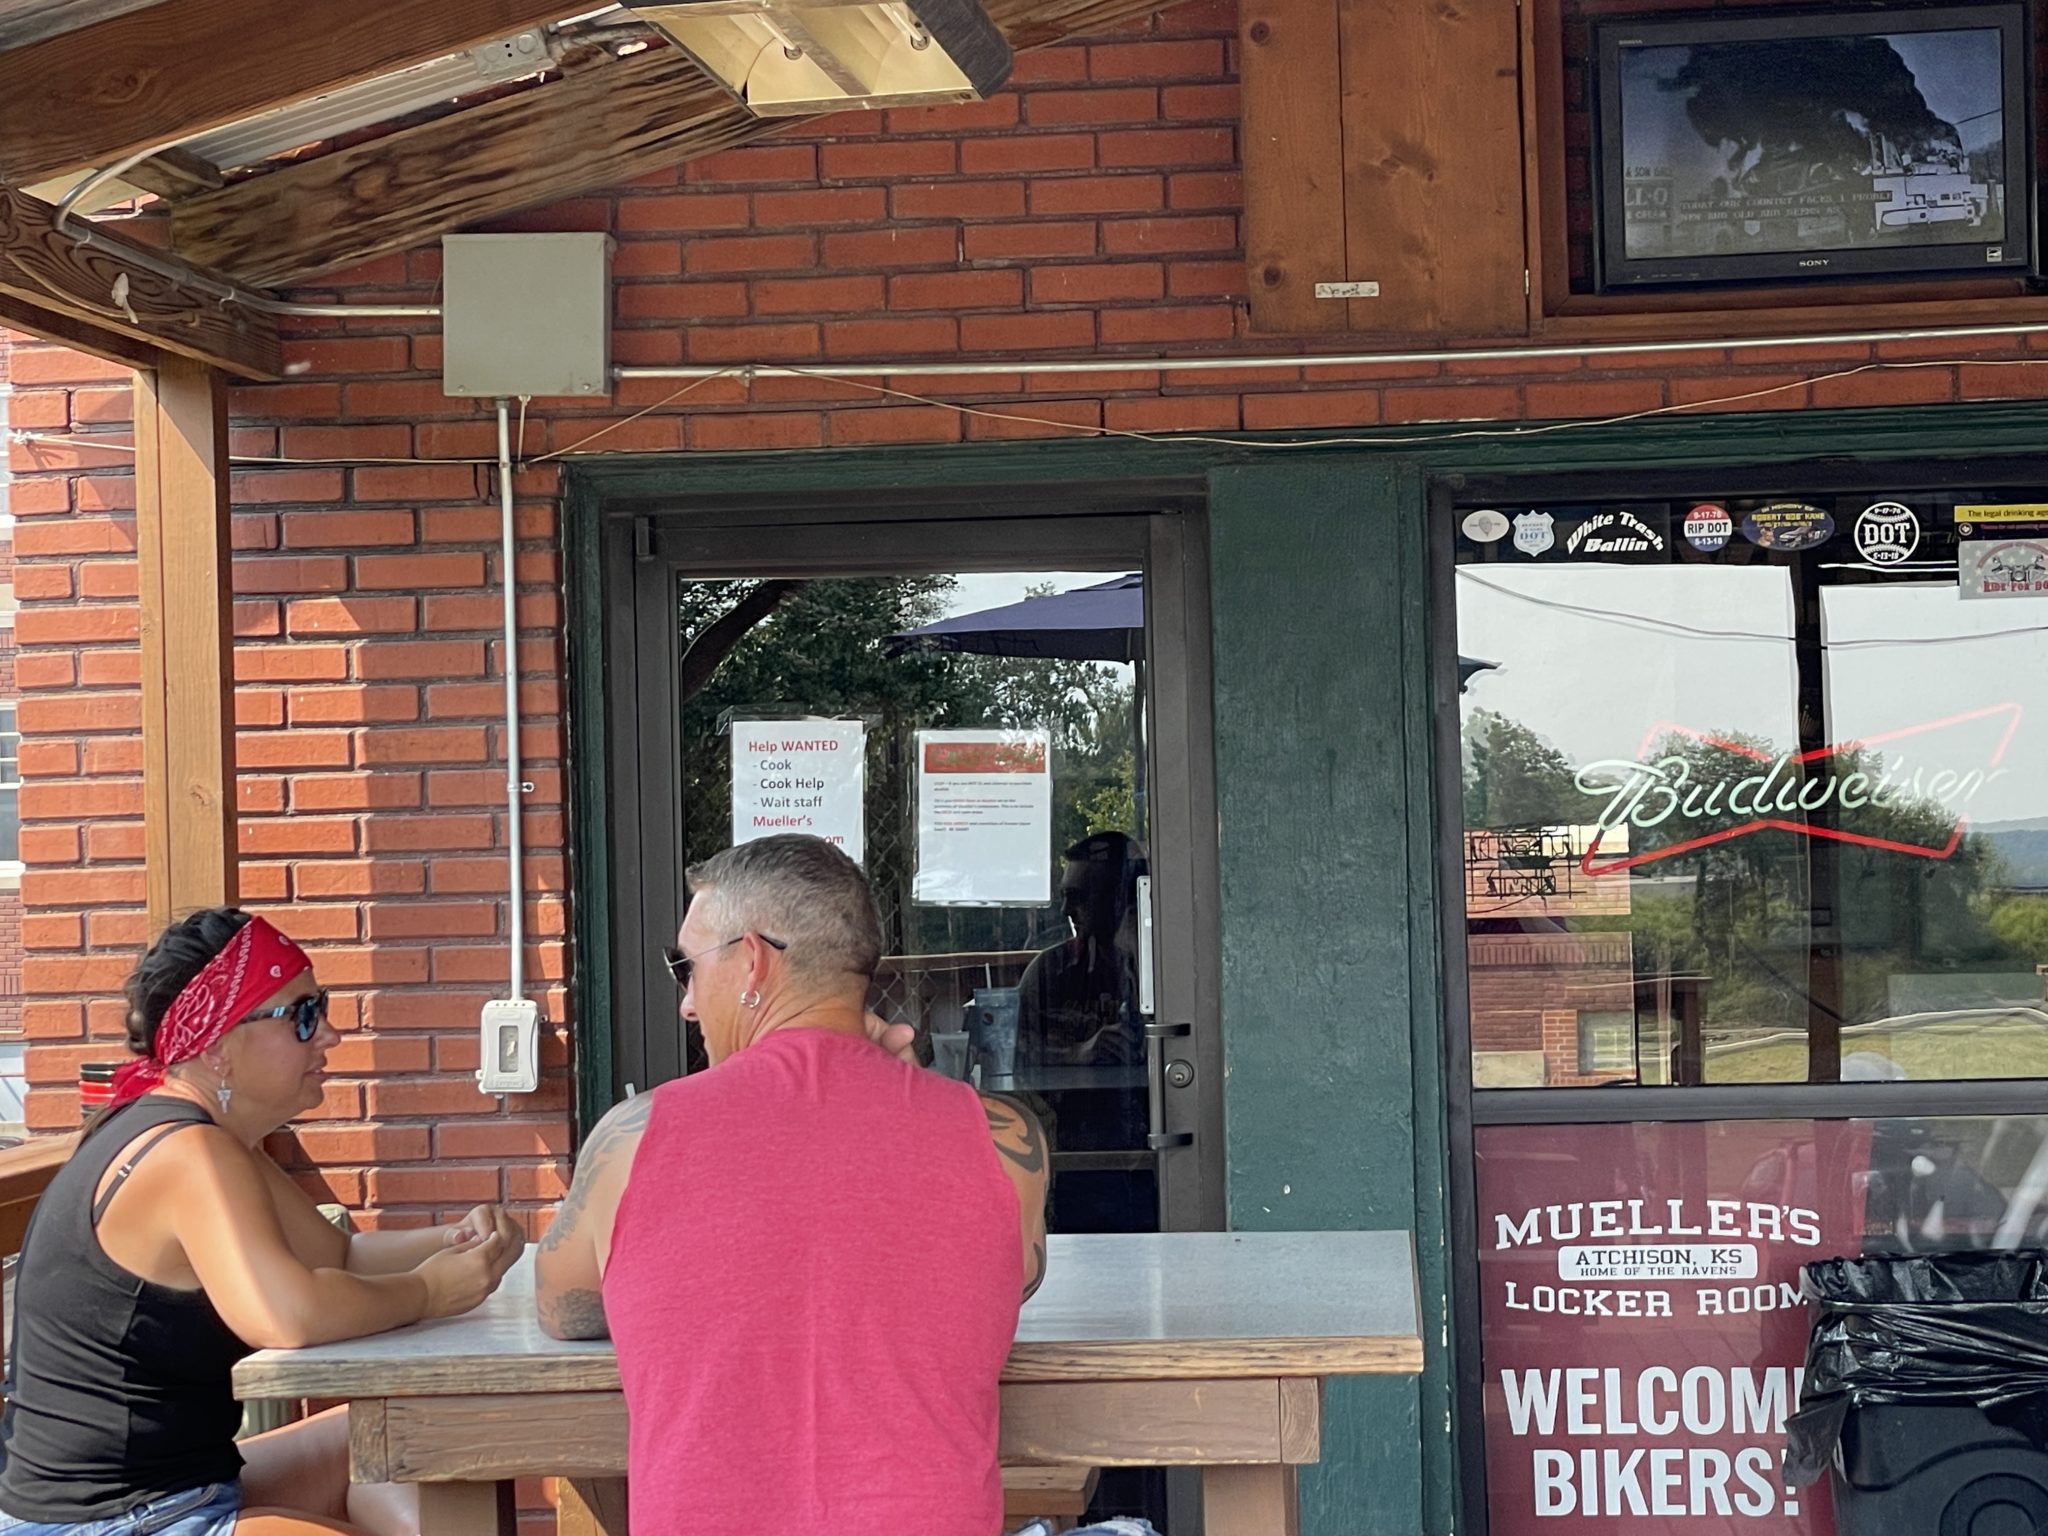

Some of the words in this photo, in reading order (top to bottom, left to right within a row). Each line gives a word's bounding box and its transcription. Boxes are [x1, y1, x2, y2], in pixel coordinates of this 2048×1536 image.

[1983, 510, 2002, 518] legal
[1566, 514, 1614, 554] White
[1619, 511, 1664, 551] Trash
[1687, 523, 1705, 534] RIP
[1708, 522, 1728, 533] DOT
[1863, 523, 1910, 545] DOT
[1584, 537, 1649, 552] Ballin
[748, 741, 777, 754] Help
[781, 740, 838, 751] WANTED
[760, 759, 792, 770] Cook
[760, 778, 792, 789] Cook
[795, 777, 824, 791] Help
[1574, 754, 2008, 831] Budweiser
[760, 797, 790, 808] Wait
[794, 796, 823, 807] staff
[753, 815, 812, 827] Mueller's
[1495, 1199, 1821, 1250] MUELLER'S
[1575, 1250, 1697, 1266] ATCHISON,
[1711, 1249, 1742, 1264] KS
[1581, 1268, 1617, 1277] HOME
[1624, 1267, 1640, 1276] OF
[1648, 1267, 1674, 1275] THE
[1681, 1266, 1737, 1276] RAVENS
[1505, 1281, 1673, 1317] LOCKER
[1697, 1282, 1808, 1316] ROOM
